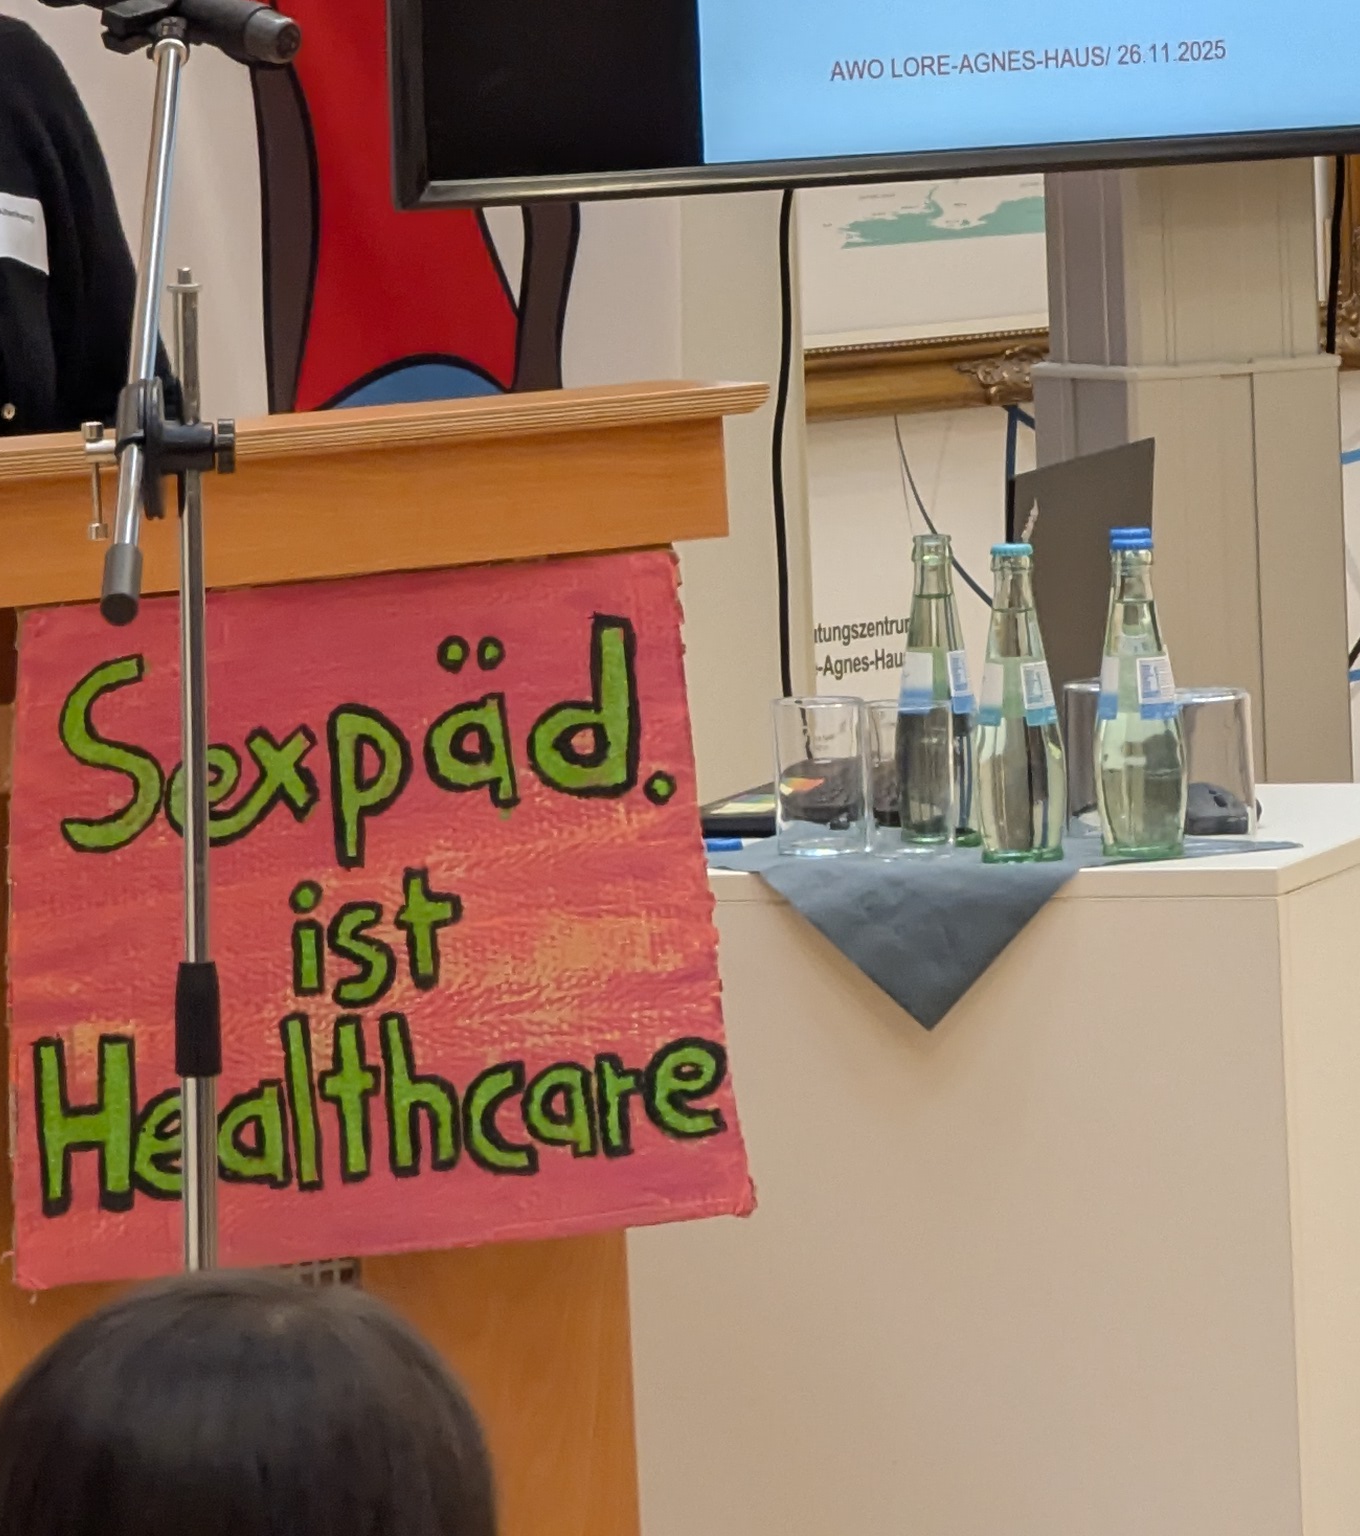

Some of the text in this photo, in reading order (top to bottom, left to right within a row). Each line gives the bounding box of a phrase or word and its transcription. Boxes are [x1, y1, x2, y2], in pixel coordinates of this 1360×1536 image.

[829, 39, 1227, 82] AWO LORE-AGNES-HAUS/ 26.11.2025
[57, 611, 678, 870] Sexpäd.
[289, 867, 464, 1009] ist
[31, 1012, 728, 1218] Healthcare
